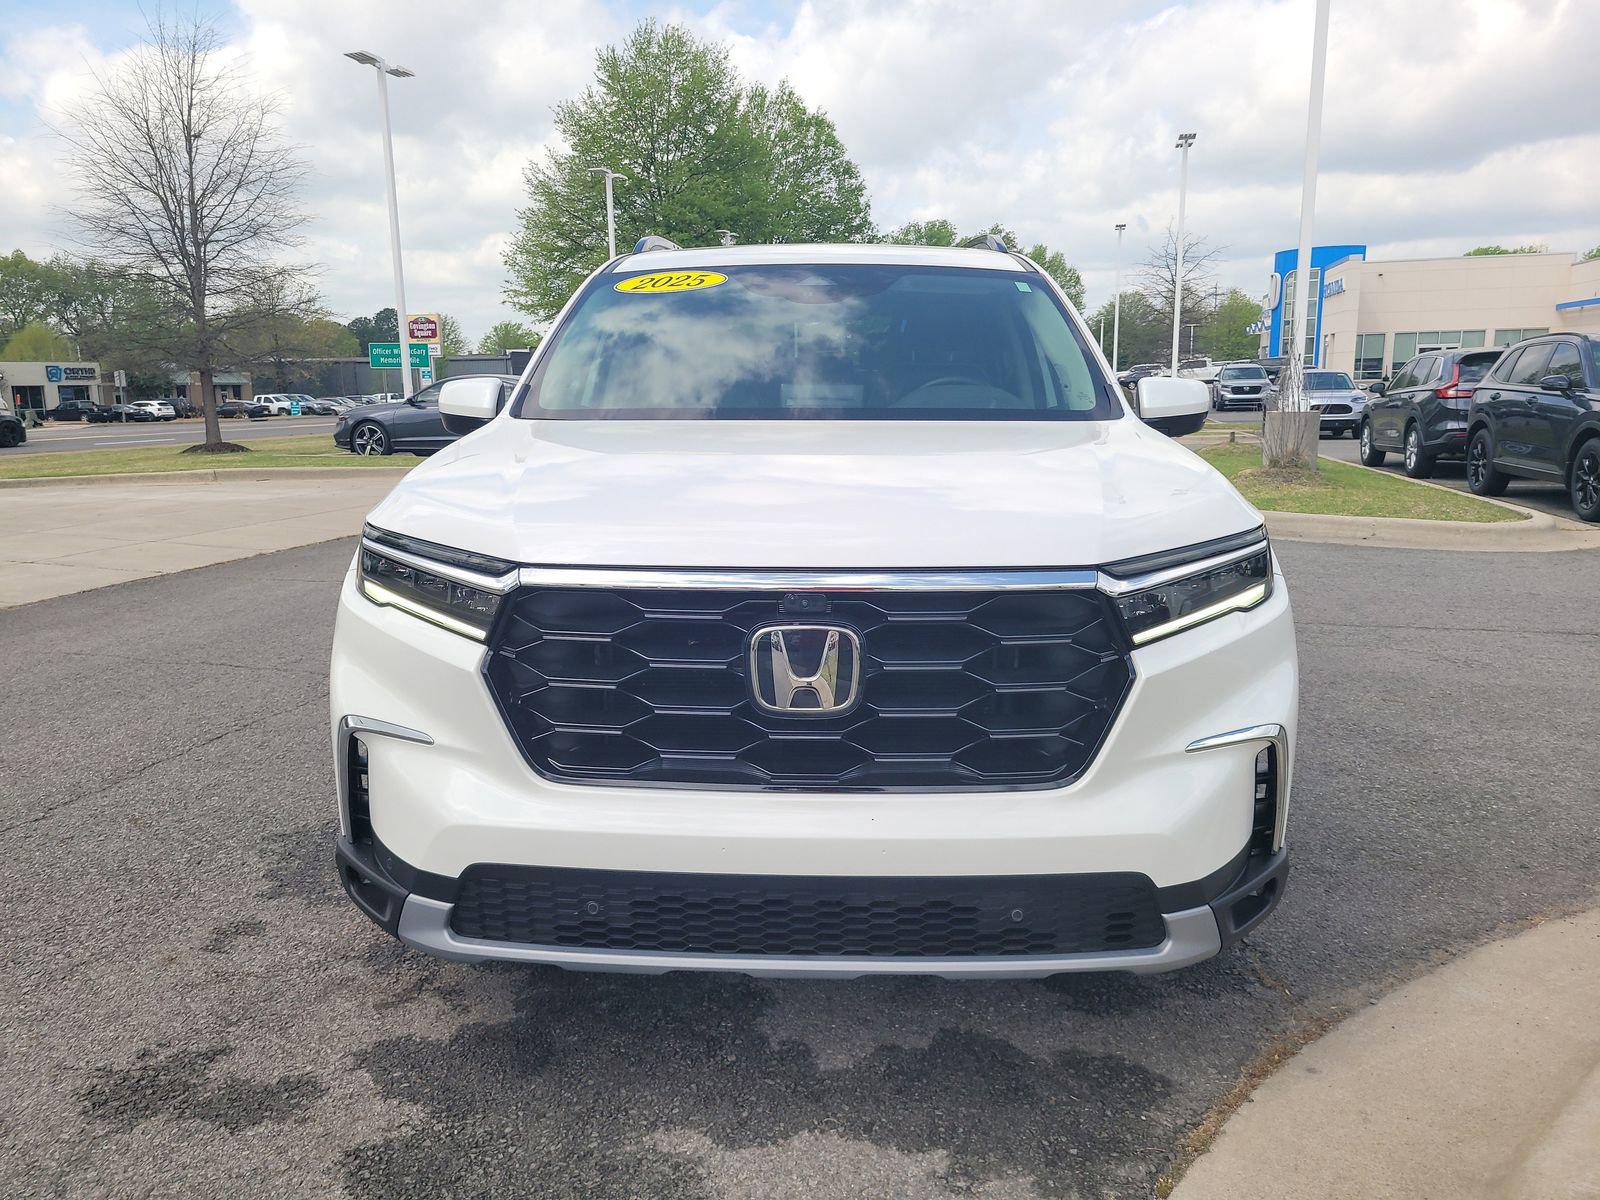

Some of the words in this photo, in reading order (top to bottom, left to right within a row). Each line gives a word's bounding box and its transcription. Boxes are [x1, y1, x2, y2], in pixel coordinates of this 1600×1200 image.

[631, 274, 709, 290] 2025
[414, 329, 432, 338] Square
[410, 348, 426, 357] cGary
